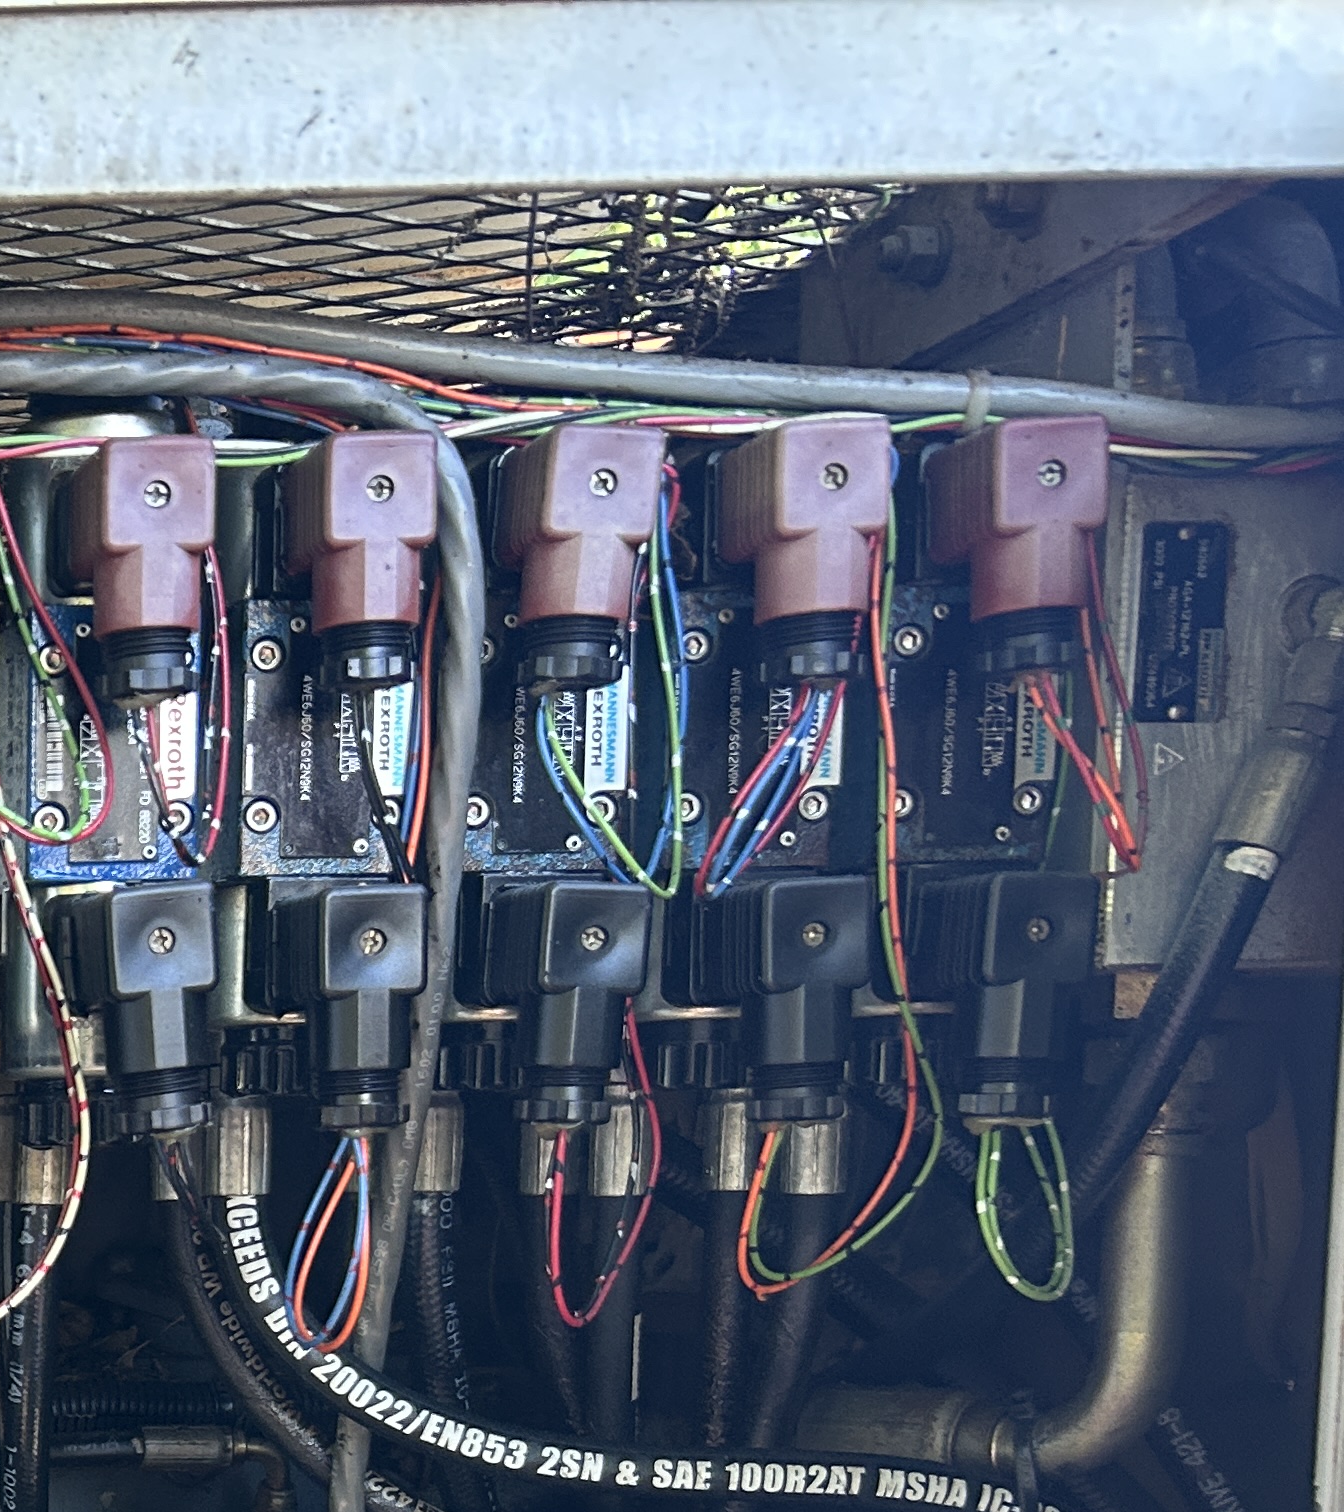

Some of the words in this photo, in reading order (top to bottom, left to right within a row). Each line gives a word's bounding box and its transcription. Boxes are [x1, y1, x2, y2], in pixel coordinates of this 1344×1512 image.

[166, 693, 187, 791] Rexroth
[379, 688, 392, 772] EXROTH
[591, 690, 604, 767] EXROTH
[225, 1195, 281, 1304] XCEEDS
[310, 1350, 530, 1471] 20022/EN853
[536, 1445, 605, 1484] 2SN
[615, 1460, 642, 1486] &
[652, 1460, 713, 1492] SAE
[725, 1461, 866, 1497] 100R2AT
[875, 1471, 968, 1509] MSHA
